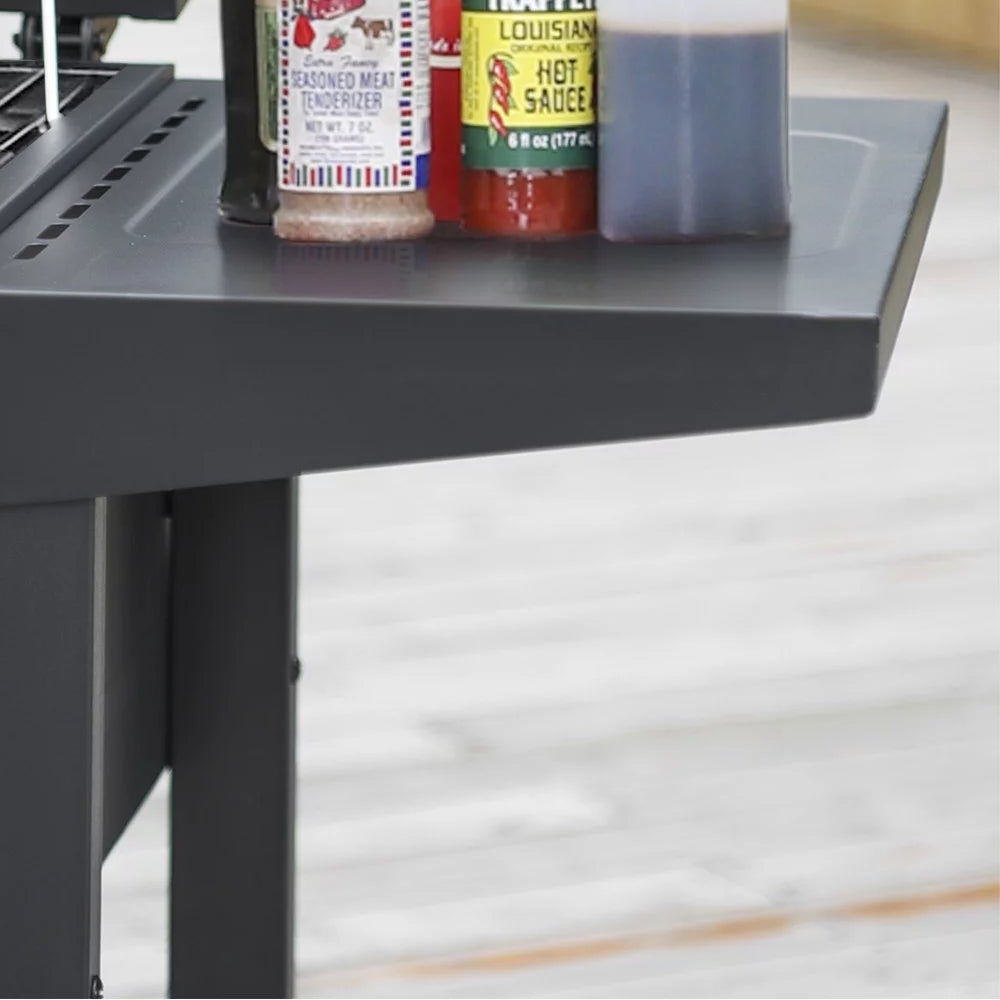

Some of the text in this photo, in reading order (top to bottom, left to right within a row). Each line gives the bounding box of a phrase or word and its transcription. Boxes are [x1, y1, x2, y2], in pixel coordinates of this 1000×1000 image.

[291, 70, 396, 89] SEASONED MEAT
[536, 59, 578, 85] HOT
[301, 91, 383, 109] TENDERIZER
[524, 86, 586, 113] SAUCE
[306, 121, 323, 133] NET
[507, 132, 518, 149] 6
[532, 134, 550, 149] oz
